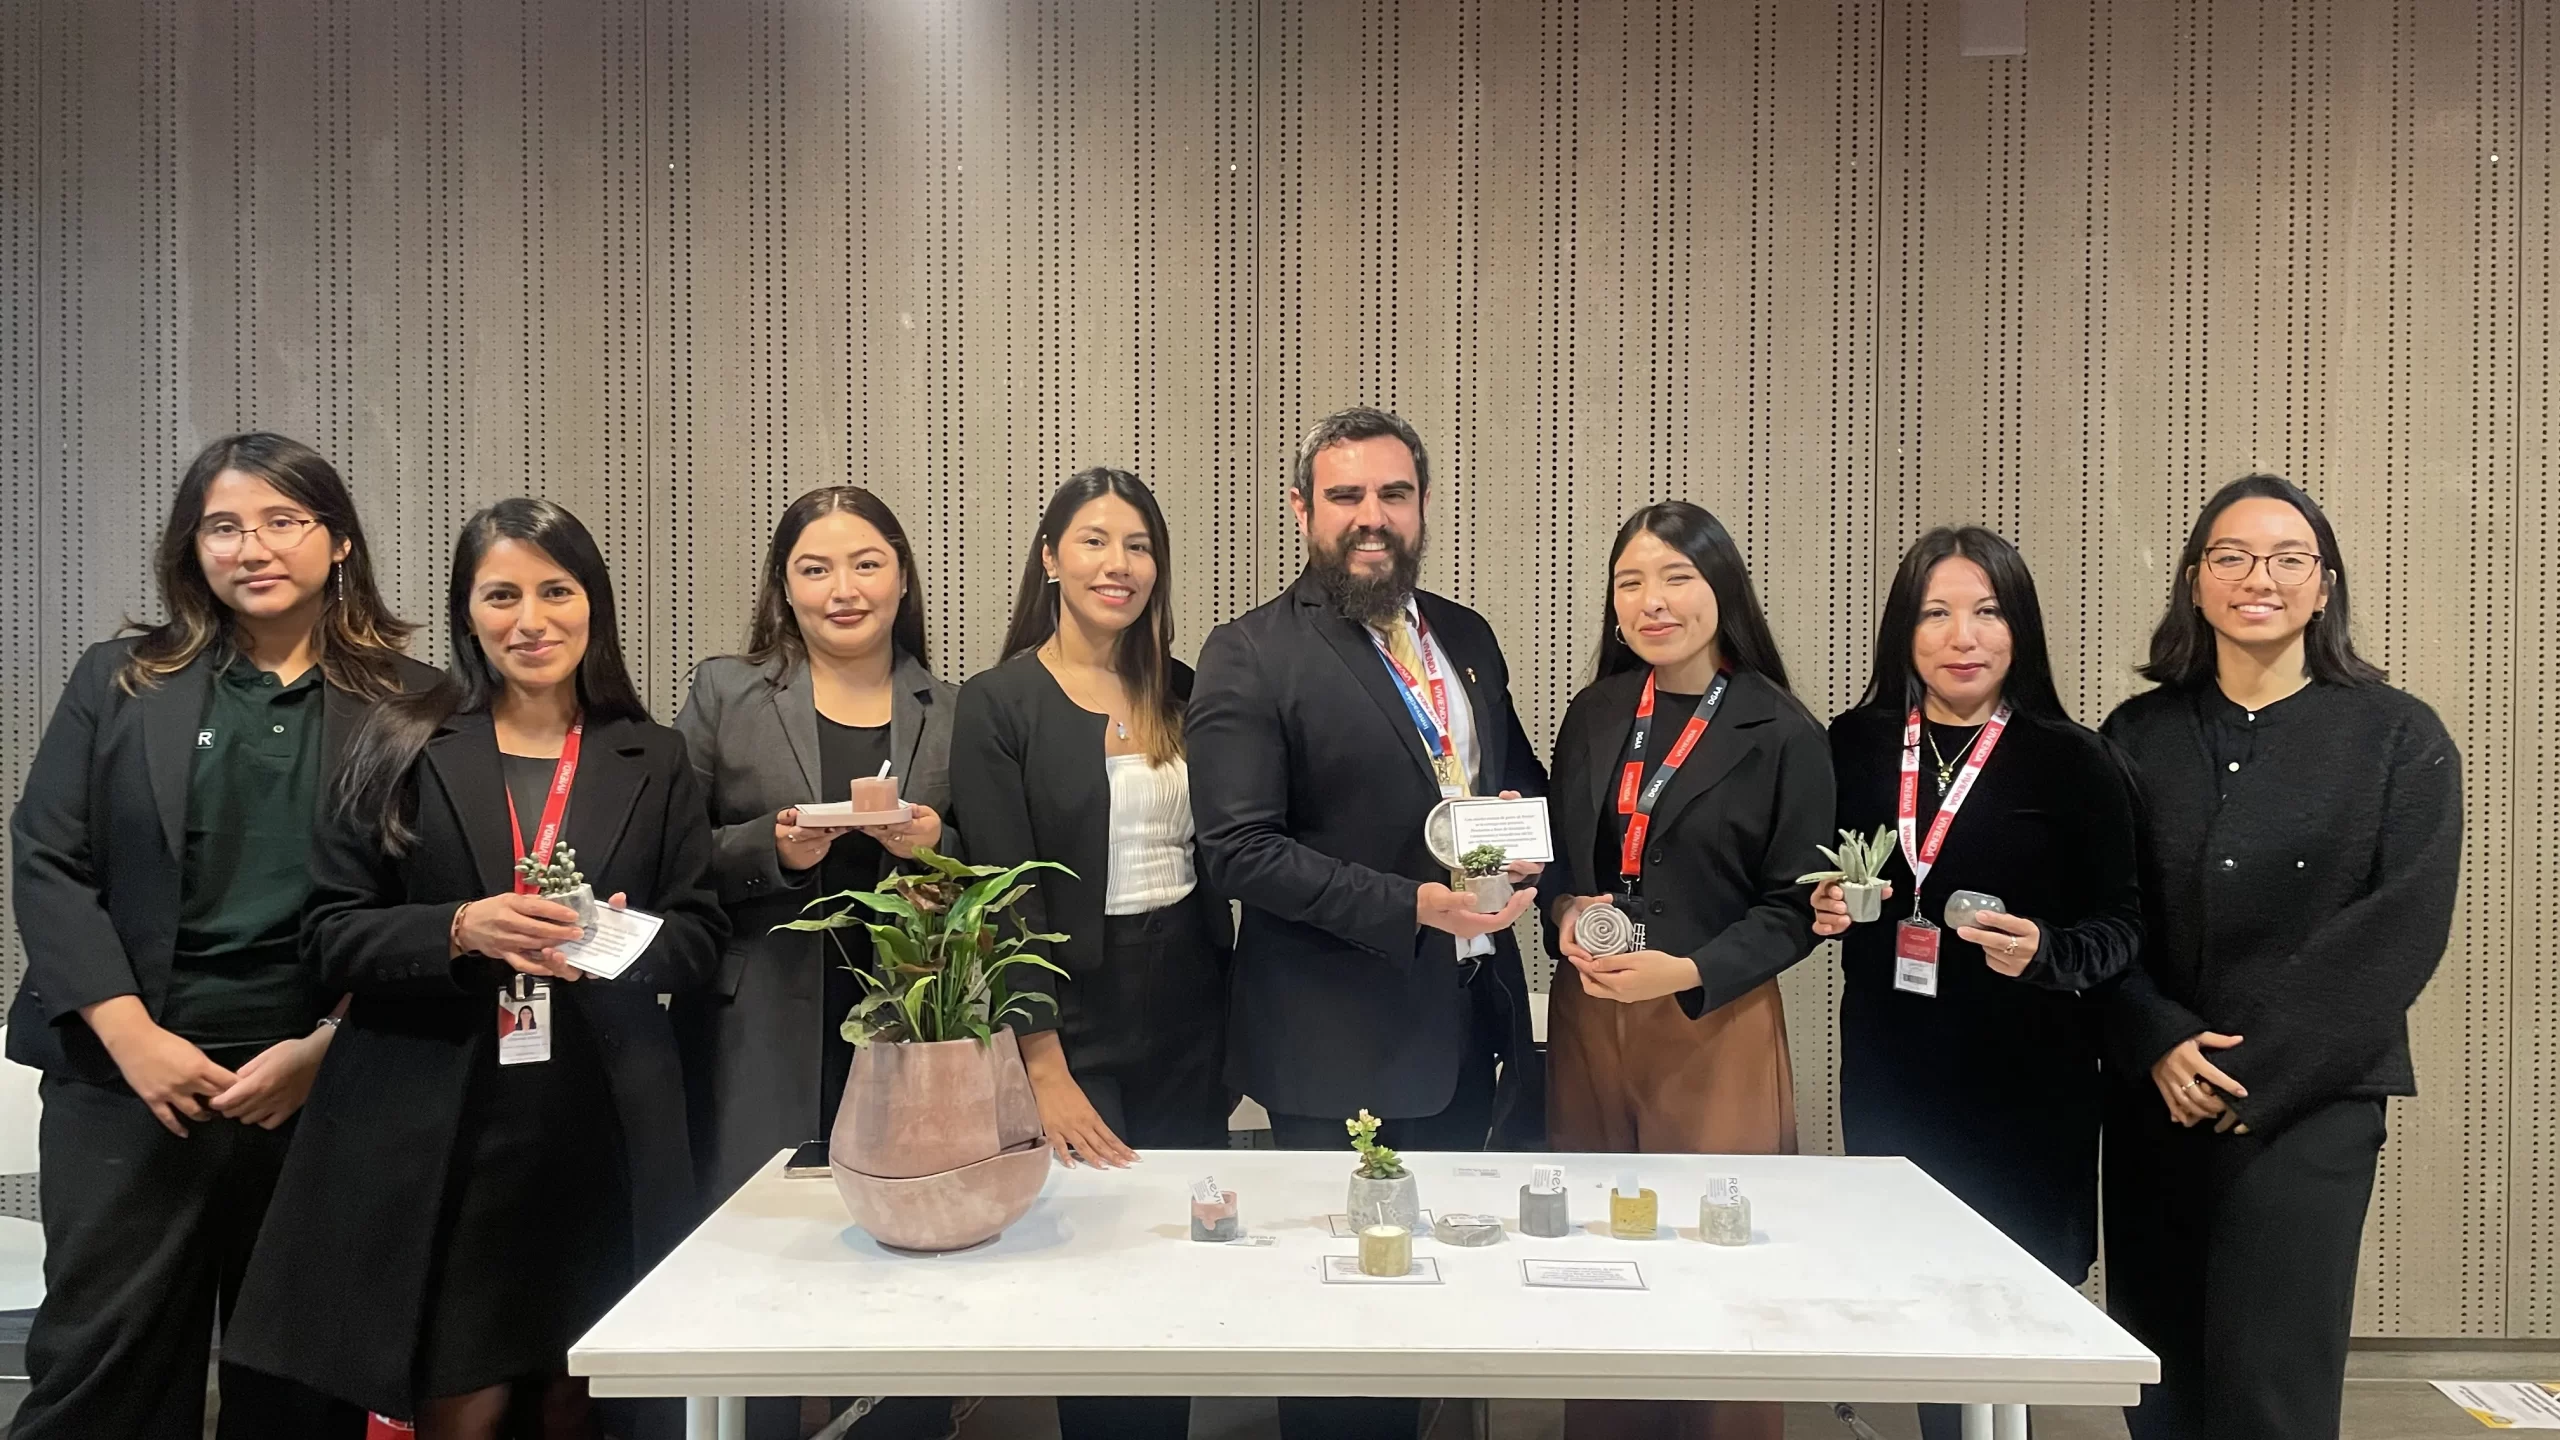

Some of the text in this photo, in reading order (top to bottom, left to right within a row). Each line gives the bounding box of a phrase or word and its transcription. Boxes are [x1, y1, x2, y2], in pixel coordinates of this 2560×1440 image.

[1422, 639, 1438, 675] VIVIENDA
[1434, 685, 1447, 725] VIVIENDA
[1707, 686, 1724, 706] DGAA
[1634, 731, 1645, 750] DGAA
[1675, 729, 1698, 758] VIVIENDA
[1974, 727, 2000, 763] VIVIENDA
[1648, 779, 1664, 798] DGAA
[1903, 775, 1915, 813] VIVIENDA
[1948, 772, 1975, 806] VIVIENDA
[1629, 826, 1643, 861] VIVIENDA
[1925, 816, 1950, 857] VIVIENDA
